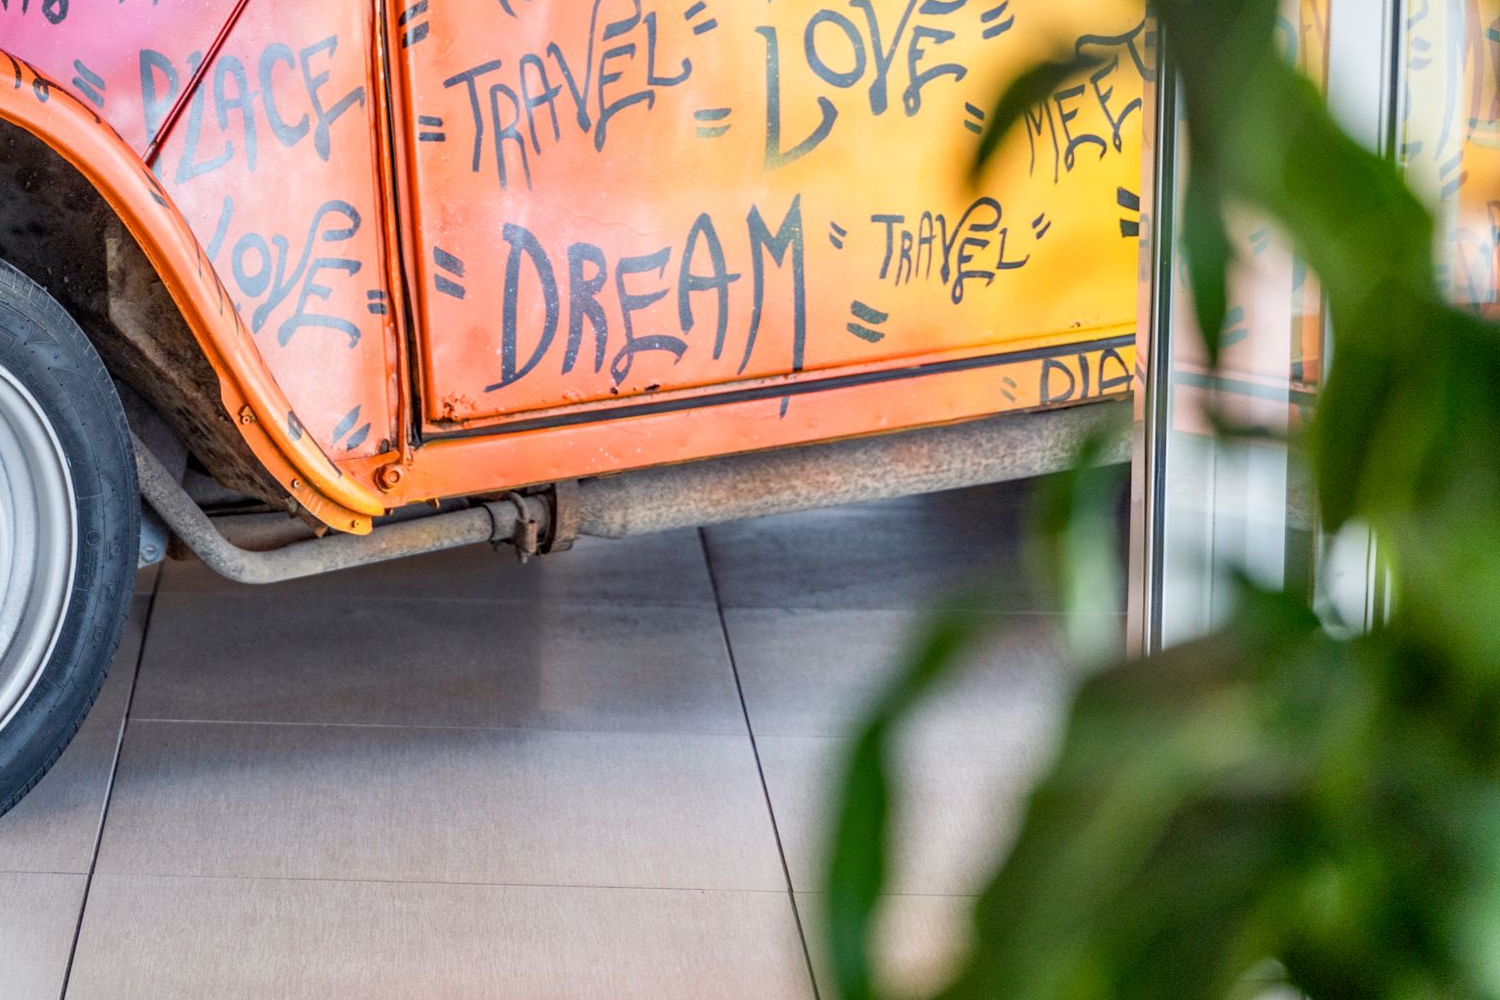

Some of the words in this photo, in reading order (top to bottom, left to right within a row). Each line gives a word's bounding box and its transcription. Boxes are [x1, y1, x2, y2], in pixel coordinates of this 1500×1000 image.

[139, 34, 367, 187] PLACE
[1027, 20, 1146, 185] MEET
[483, 193, 806, 418] DREAM
[871, 197, 1031, 305] TRAVEL
